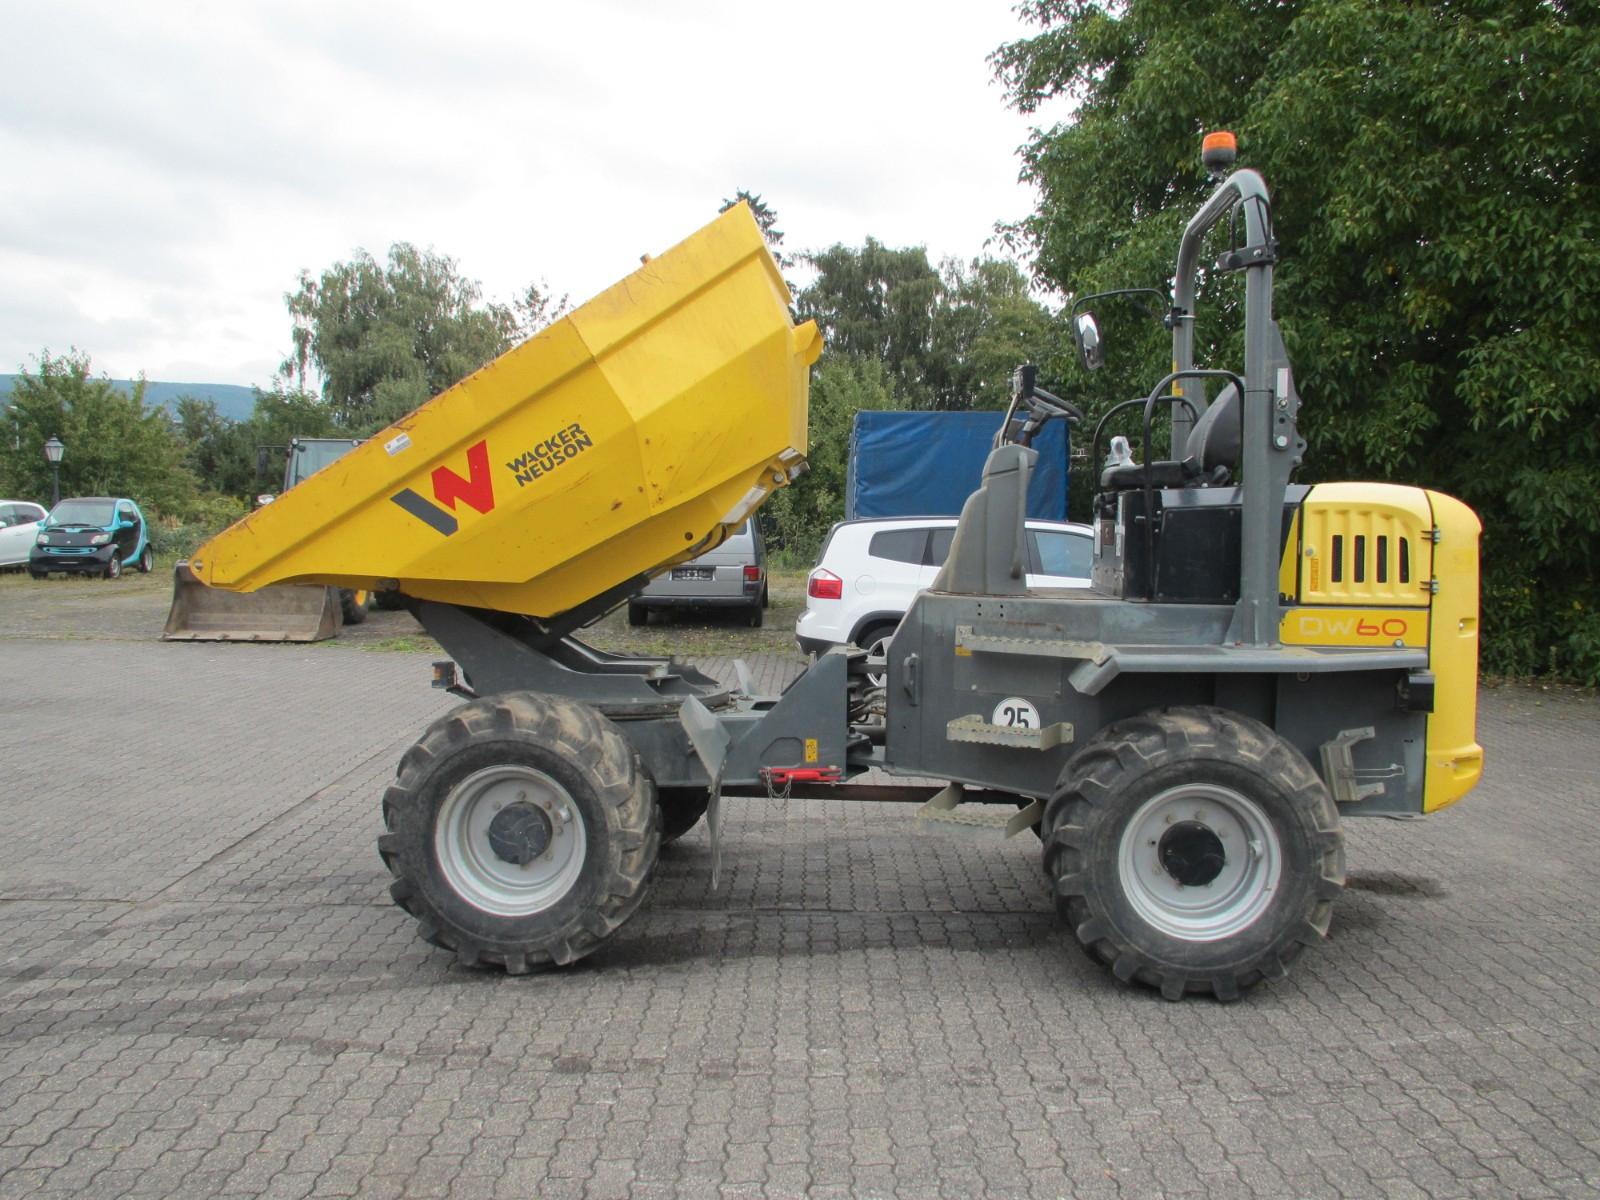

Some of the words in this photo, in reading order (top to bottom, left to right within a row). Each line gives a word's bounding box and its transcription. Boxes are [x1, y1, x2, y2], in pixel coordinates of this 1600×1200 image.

[505, 423, 586, 473] WACKER
[514, 434, 593, 487] NEUSON
[1299, 617, 1408, 637] DW60
[1003, 706, 1029, 729] 25
